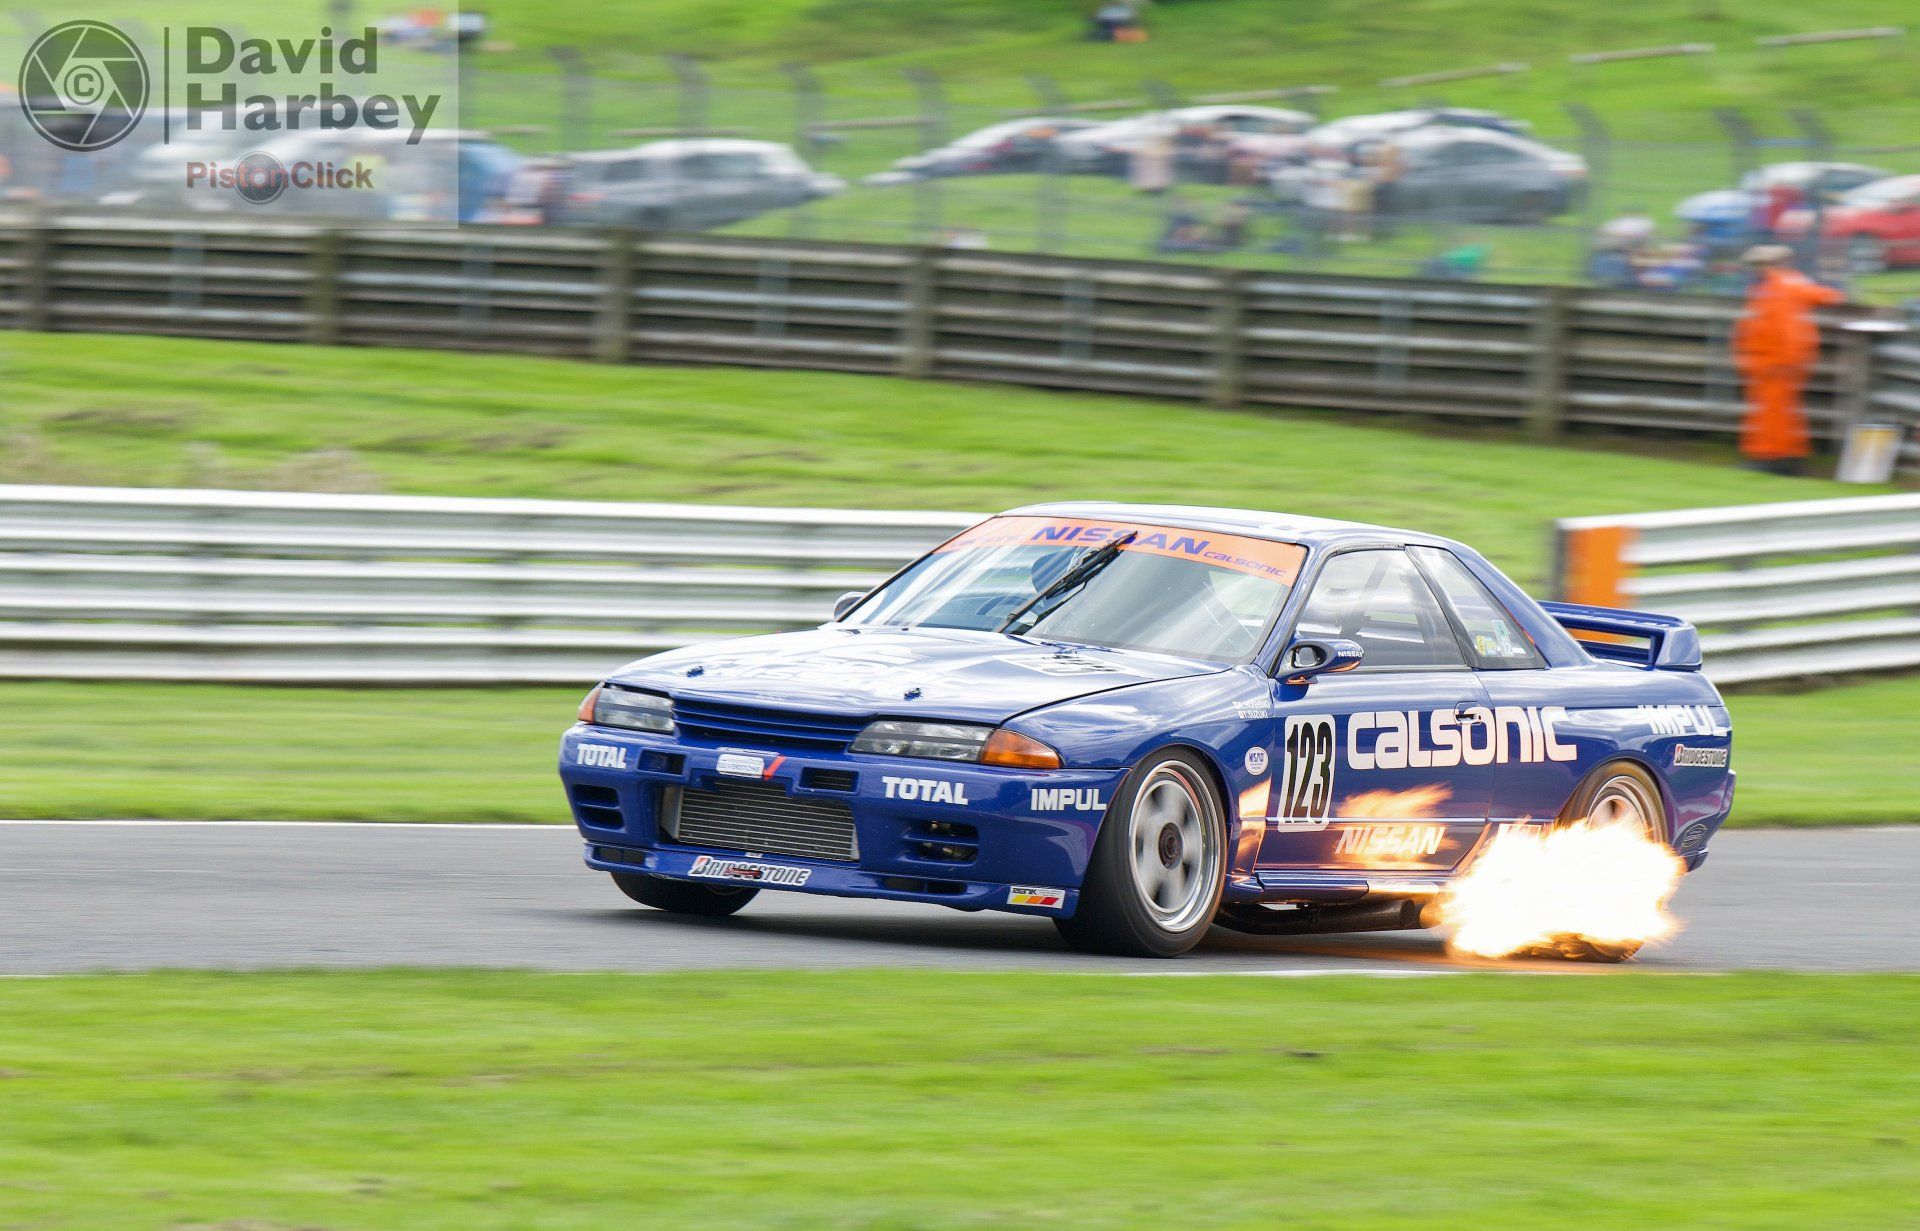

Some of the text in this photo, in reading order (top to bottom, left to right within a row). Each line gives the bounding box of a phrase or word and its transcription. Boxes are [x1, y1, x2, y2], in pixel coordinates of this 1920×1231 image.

[1637, 705, 1728, 737] IMPUL
[577, 743, 627, 769] TOTAL
[1283, 721, 1333, 824] 123
[881, 776, 969, 806] TOTAL
[1031, 788, 1107, 811] IMPUL
[1335, 826, 1446, 855] NISSAN
